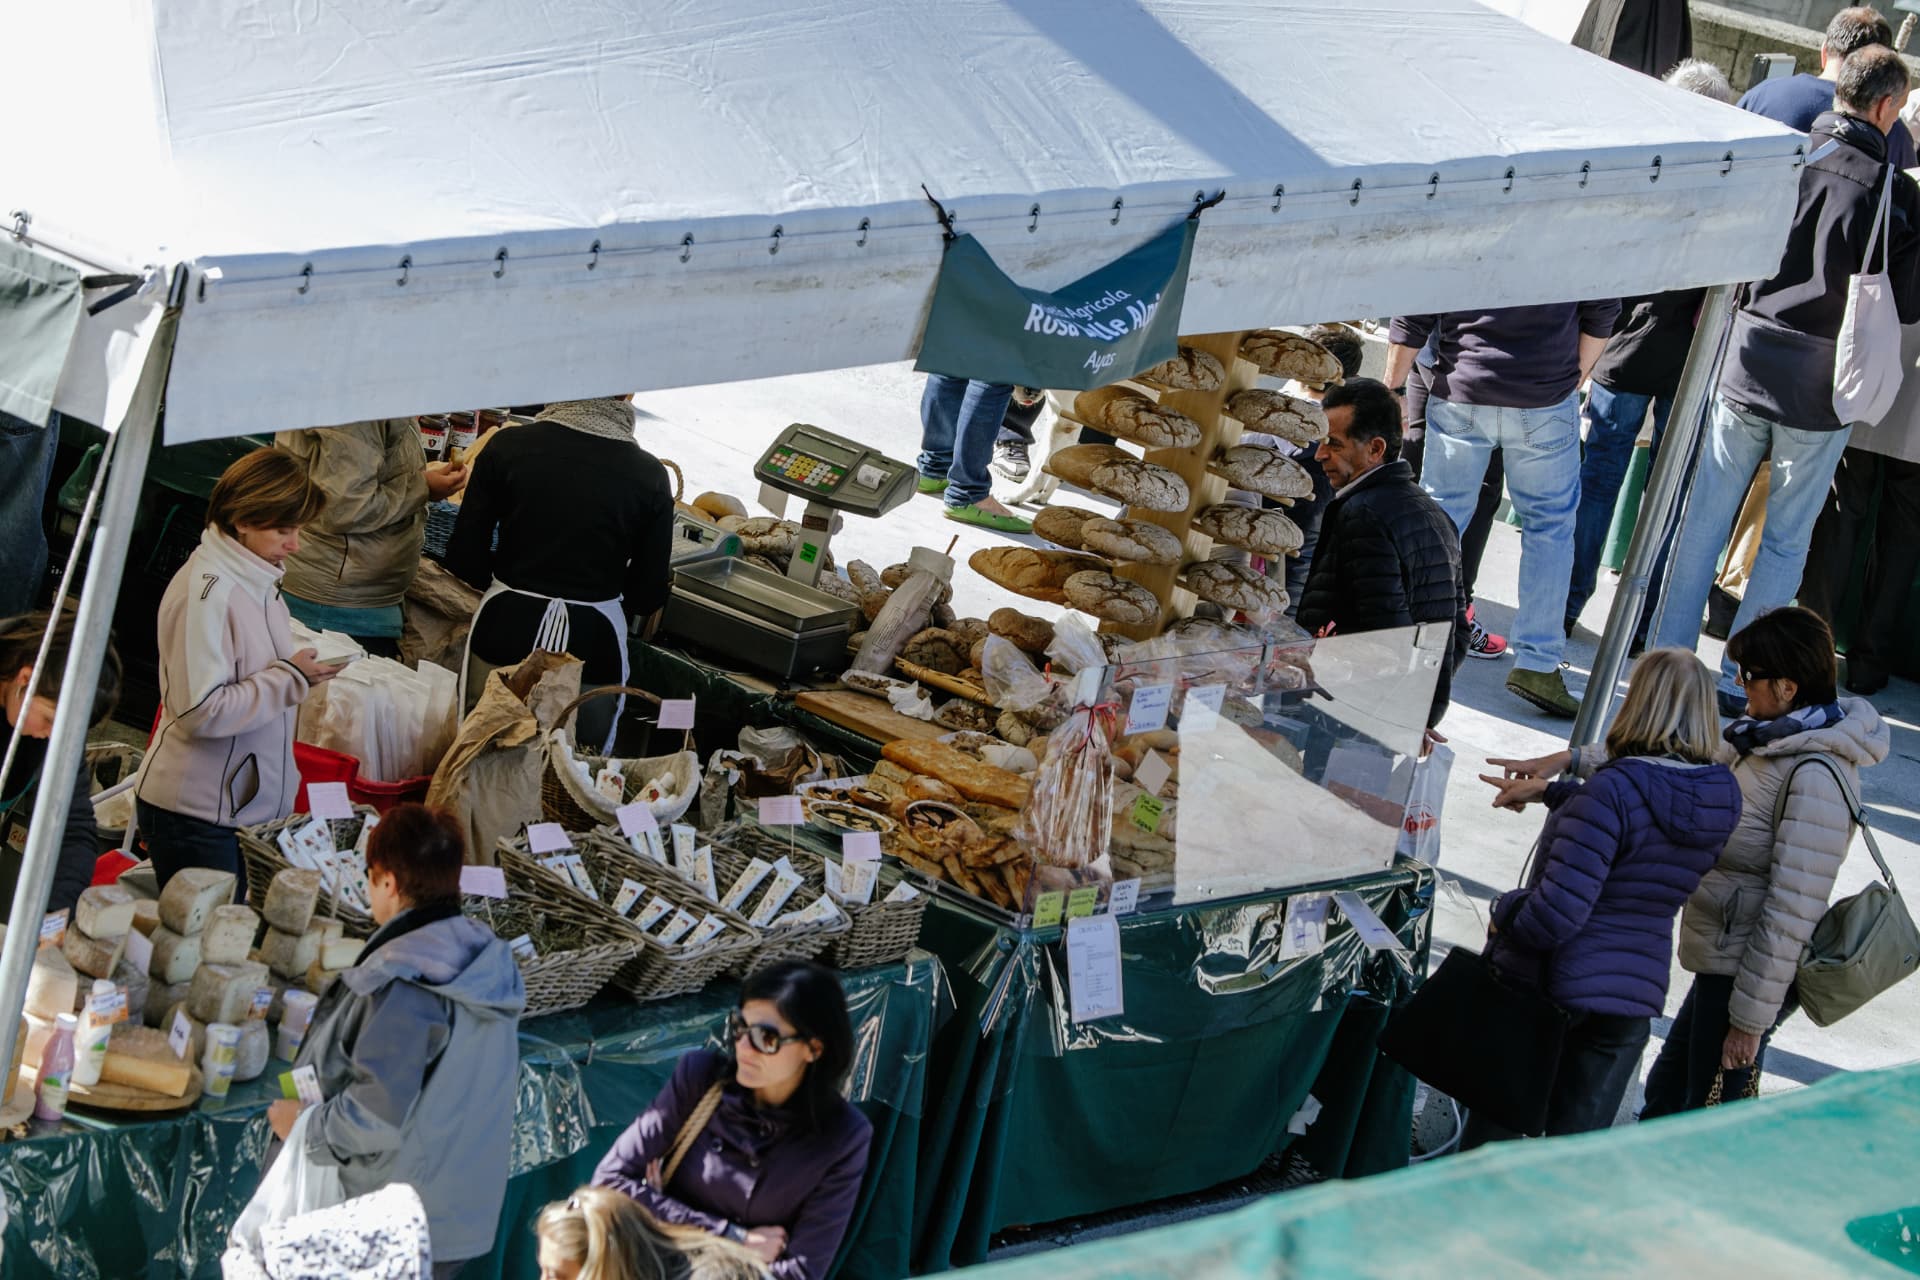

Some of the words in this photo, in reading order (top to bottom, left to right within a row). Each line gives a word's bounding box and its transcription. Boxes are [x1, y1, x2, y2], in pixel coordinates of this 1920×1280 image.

[1065, 289, 1132, 321] Agricola
[1083, 350, 1117, 374] Ayas
[200, 573, 219, 600] 7
